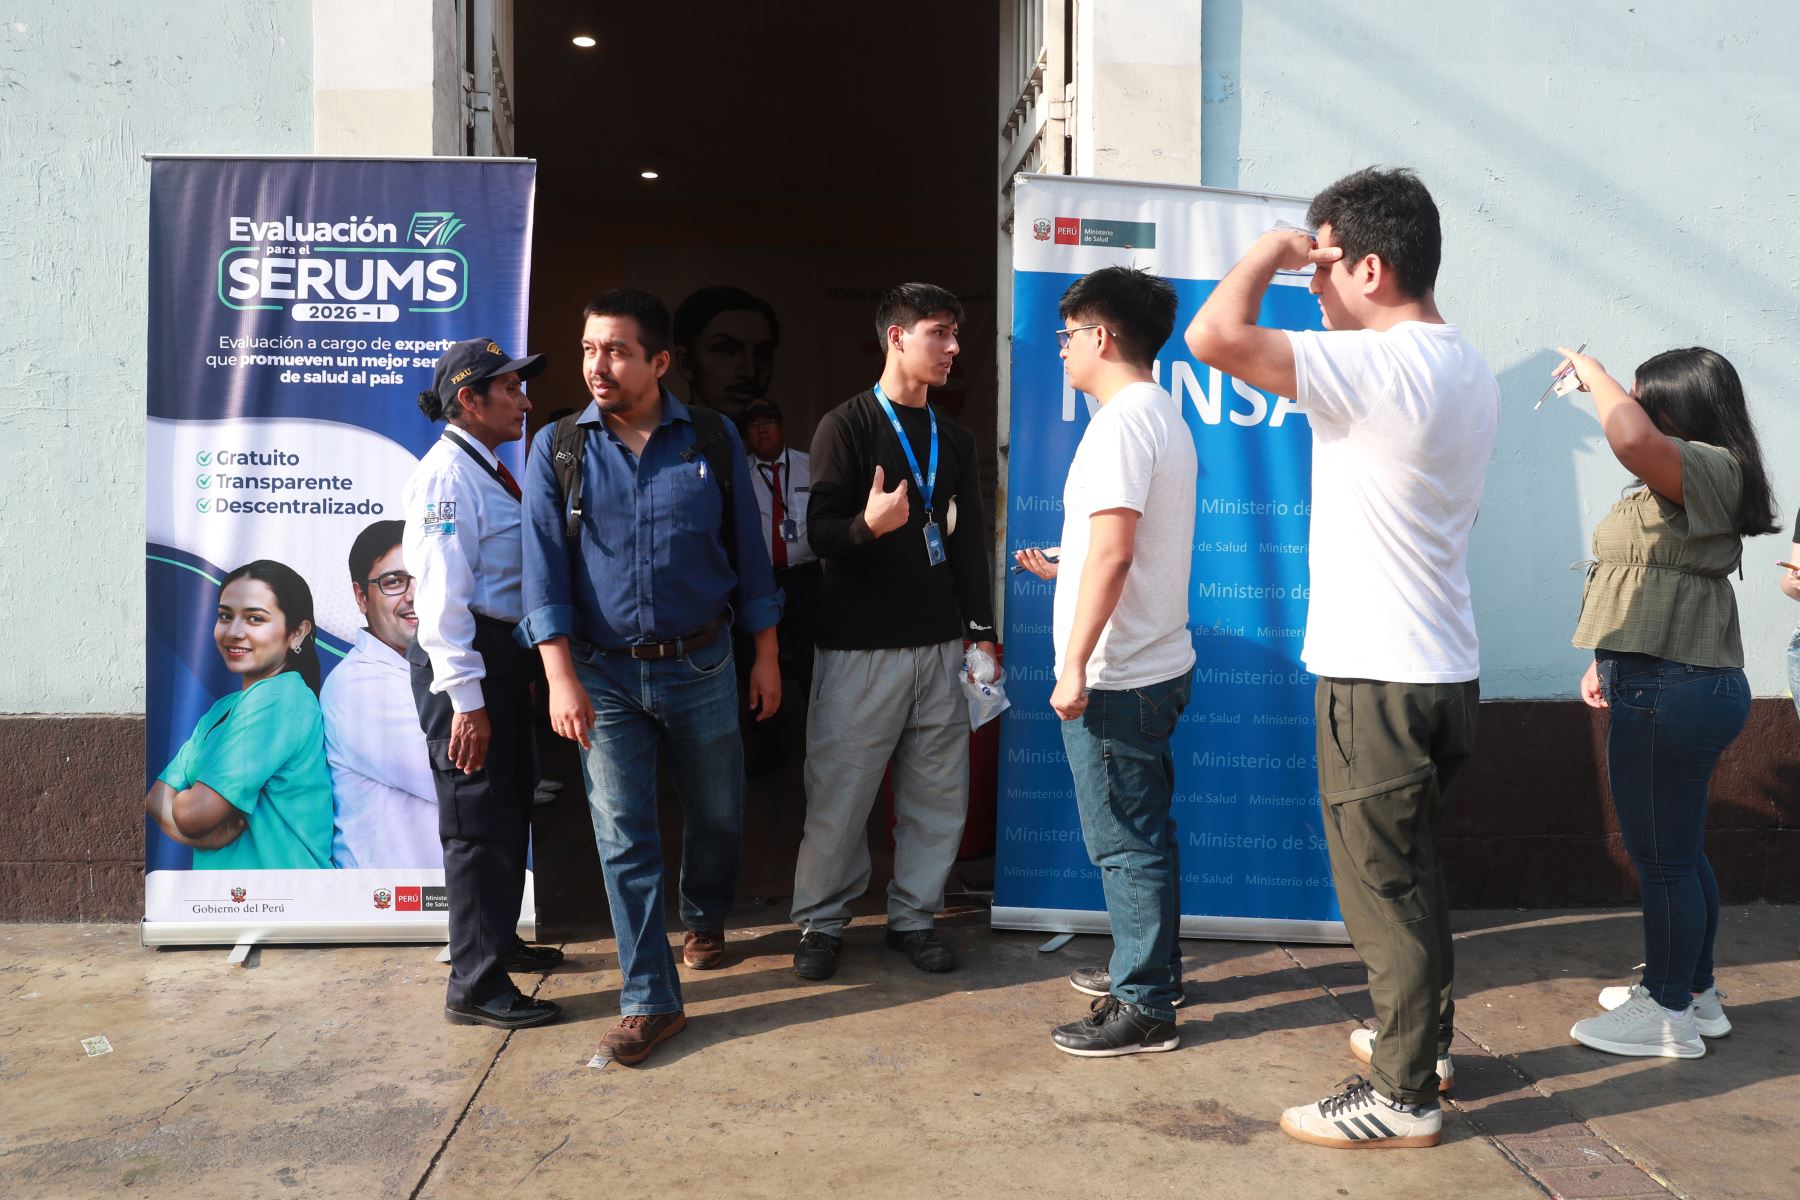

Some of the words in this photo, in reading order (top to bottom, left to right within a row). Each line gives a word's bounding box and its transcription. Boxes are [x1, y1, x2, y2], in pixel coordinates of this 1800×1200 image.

[229, 215, 397, 243] Evaluación
[1057, 226, 1077, 236] PERÚ
[1084, 228, 1114, 237] Ministerio
[1093, 235, 1109, 243] Salud
[266, 245, 295, 256] para
[298, 244, 311, 255] el
[228, 257, 457, 302] SERUMS
[309, 305, 357, 320] 2026
[219, 335, 303, 349] Evaluación
[307, 339, 317, 349] a
[321, 339, 367, 353] cargo
[371, 336, 391, 350] de
[206, 355, 237, 369] que
[240, 354, 334, 369] promueven
[336, 356, 358, 367] un
[361, 353, 410, 370] mejor
[280, 369, 301, 383] de
[303, 370, 349, 384] salud
[351, 371, 367, 384] al
[369, 371, 404, 388] país
[450, 367, 472, 385] PERU
[216, 449, 300, 466] Gratuito
[216, 473, 353, 493] Transparente
[216, 497, 384, 515] Descentralizado
[1016, 495, 1063, 512] Minis
[1201, 498, 1288, 516] Ministerio
[1015, 539, 1061, 550] Minister
[1198, 541, 1213, 552] de
[1215, 541, 1247, 553] Salud
[1259, 542, 1309, 554] Ministeri
[1199, 582, 1286, 599] Ministerio
[1290, 583, 1310, 600] de
[1012, 623, 1054, 634] Ministe
[1195, 625, 1210, 636] de
[1212, 625, 1244, 637] Salud
[1257, 627, 1305, 638] Ministeri
[1011, 665, 1056, 681] Minis
[1196, 668, 1284, 685] Ministerio
[1288, 668, 1310, 685] de
[1009, 709, 1058, 721] Minister
[1192, 712, 1207, 723] de
[1209, 712, 1240, 724] Salud
[1253, 714, 1309, 725] Ministerio
[1008, 748, 1068, 763] Ministe
[1192, 751, 1281, 769] Ministerio
[1286, 752, 1307, 769] de
[1007, 788, 1063, 799] Ministerio
[1188, 792, 1203, 803] de
[1206, 792, 1237, 804] Salud
[1249, 794, 1306, 806] Ministerio
[1005, 826, 1084, 842] Ministeri
[1189, 831, 1277, 849] Ministerio
[1282, 835, 1303, 850] de
[1004, 866, 1060, 877] Ministerio
[1063, 867, 1077, 878] de
[1080, 867, 1102, 879] Salu
[1185, 872, 1199, 883] de
[1202, 873, 1233, 884] Salud
[1245, 874, 1303, 887] Ministerio
[1305, 876, 1320, 887] de
[398, 893, 419, 903] PERÚ
[192, 904, 240, 914] Gobierno
[243, 903, 258, 913] del
[262, 903, 285, 913] Perú
